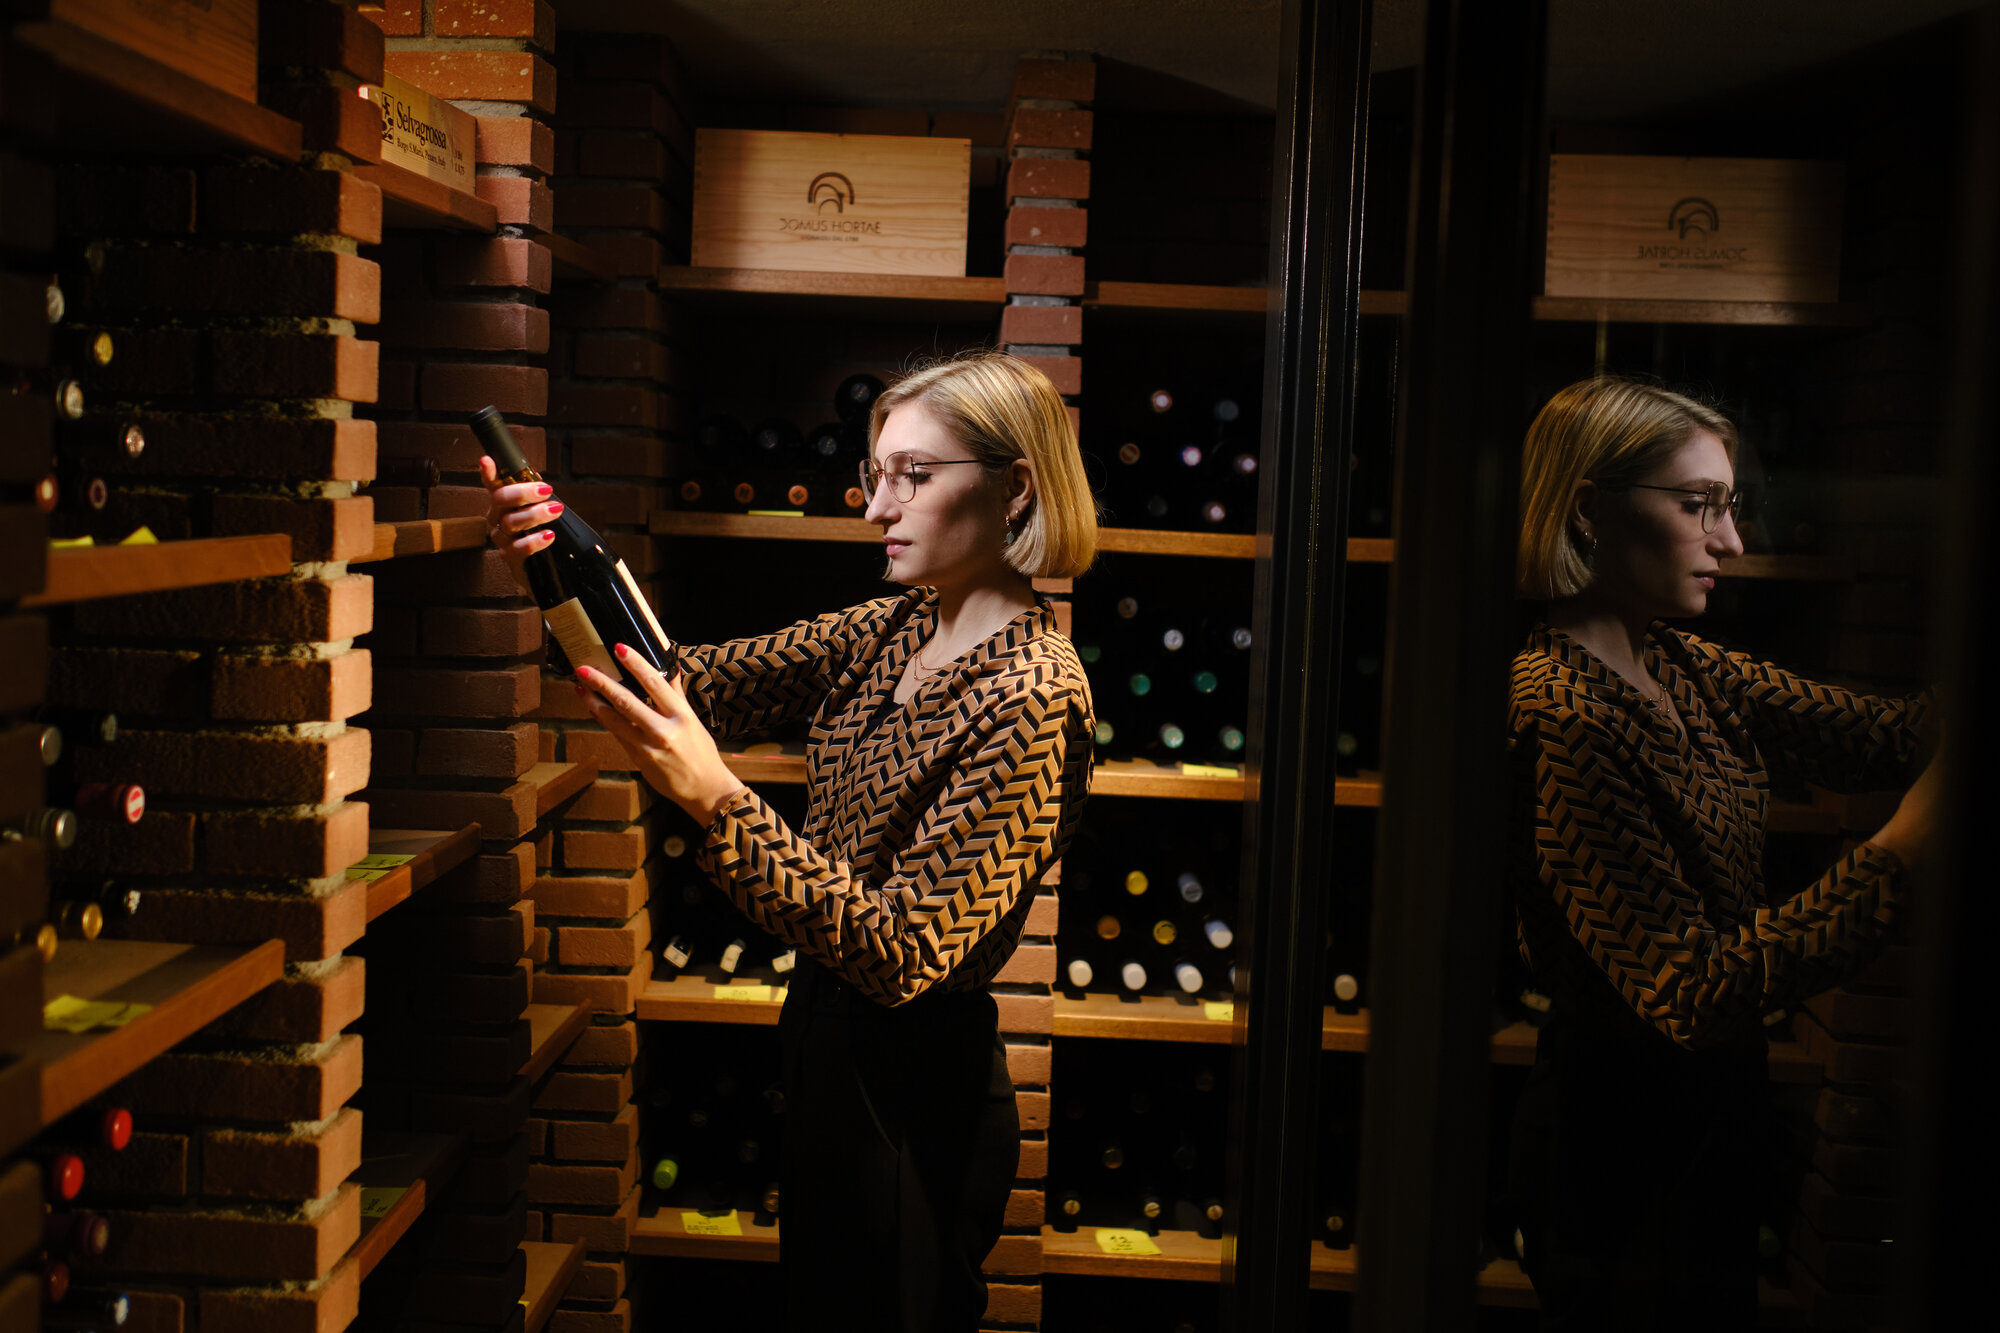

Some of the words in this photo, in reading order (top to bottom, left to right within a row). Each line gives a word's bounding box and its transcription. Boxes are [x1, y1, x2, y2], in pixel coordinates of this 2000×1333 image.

[396, 101, 447, 149] Selvagrossa
[779, 218, 828, 232] DOMUS
[832, 220, 881, 234] HORTAE
